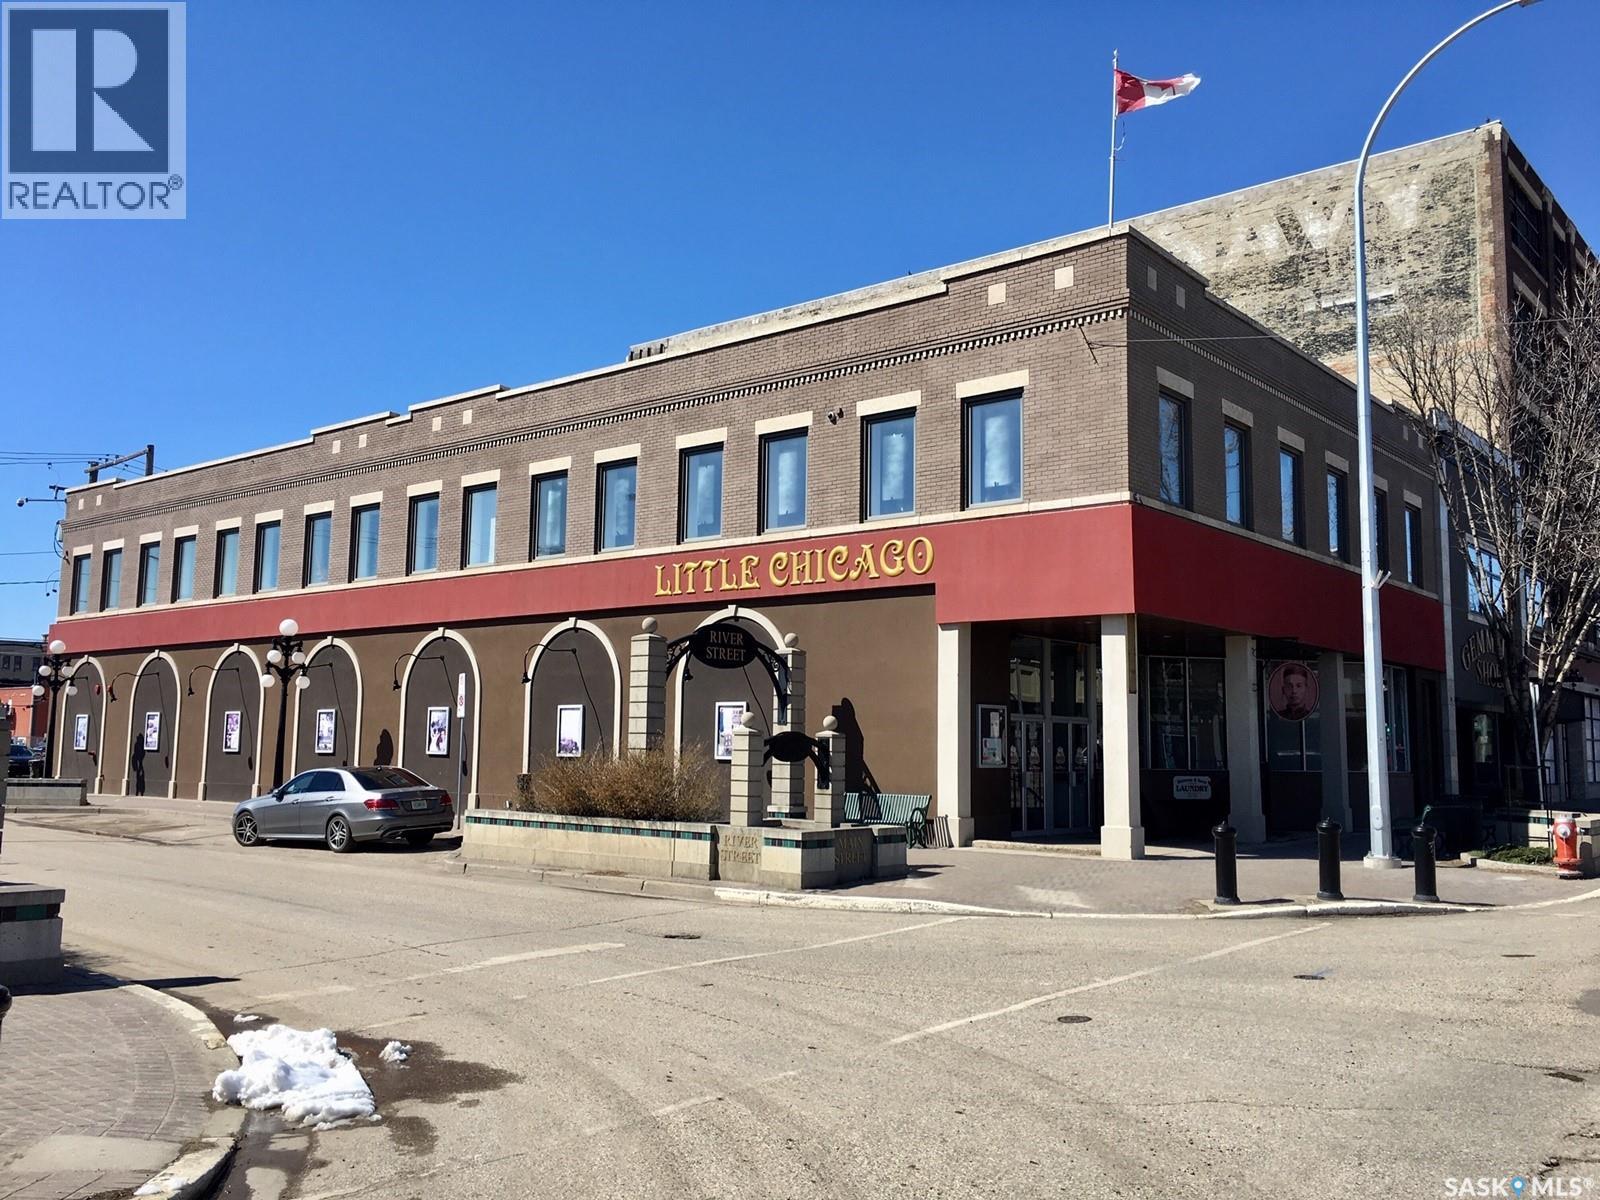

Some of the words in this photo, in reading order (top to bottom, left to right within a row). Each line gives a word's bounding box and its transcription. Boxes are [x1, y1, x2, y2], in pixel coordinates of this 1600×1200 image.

[654, 555, 761, 597] LITTLE
[768, 536, 935, 588] CHICAGO
[709, 630, 744, 644] RIVER
[705, 647, 745, 662] STREET
[1176, 785, 1208, 793] LAUNDRY
[724, 834, 759, 849] RIVER
[720, 849, 760, 864] STREET
